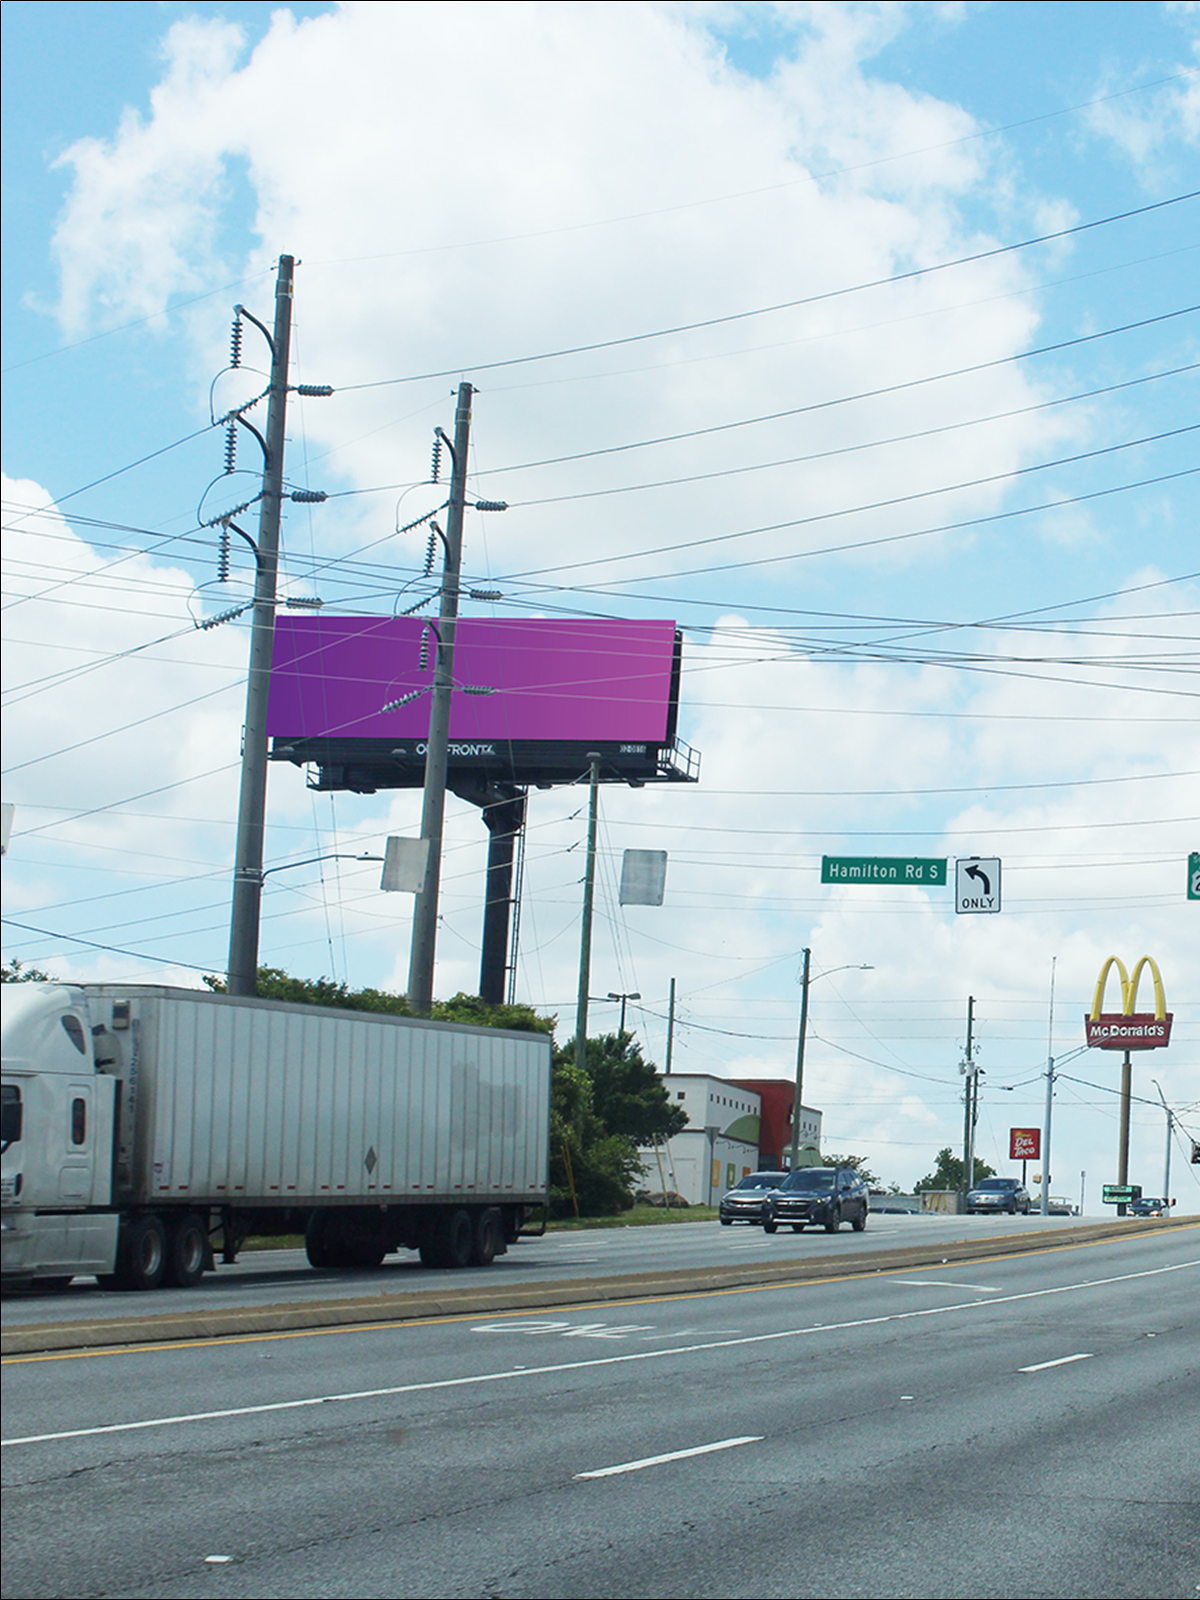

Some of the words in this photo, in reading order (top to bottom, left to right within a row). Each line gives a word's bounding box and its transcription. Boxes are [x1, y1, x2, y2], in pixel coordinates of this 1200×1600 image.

[829, 863, 897, 878] Hamilton
[905, 864, 923, 878] Rd
[929, 865, 938, 879] S
[962, 897, 995, 909] ONLY
[1090, 1025, 1165, 1037] McDonald's
